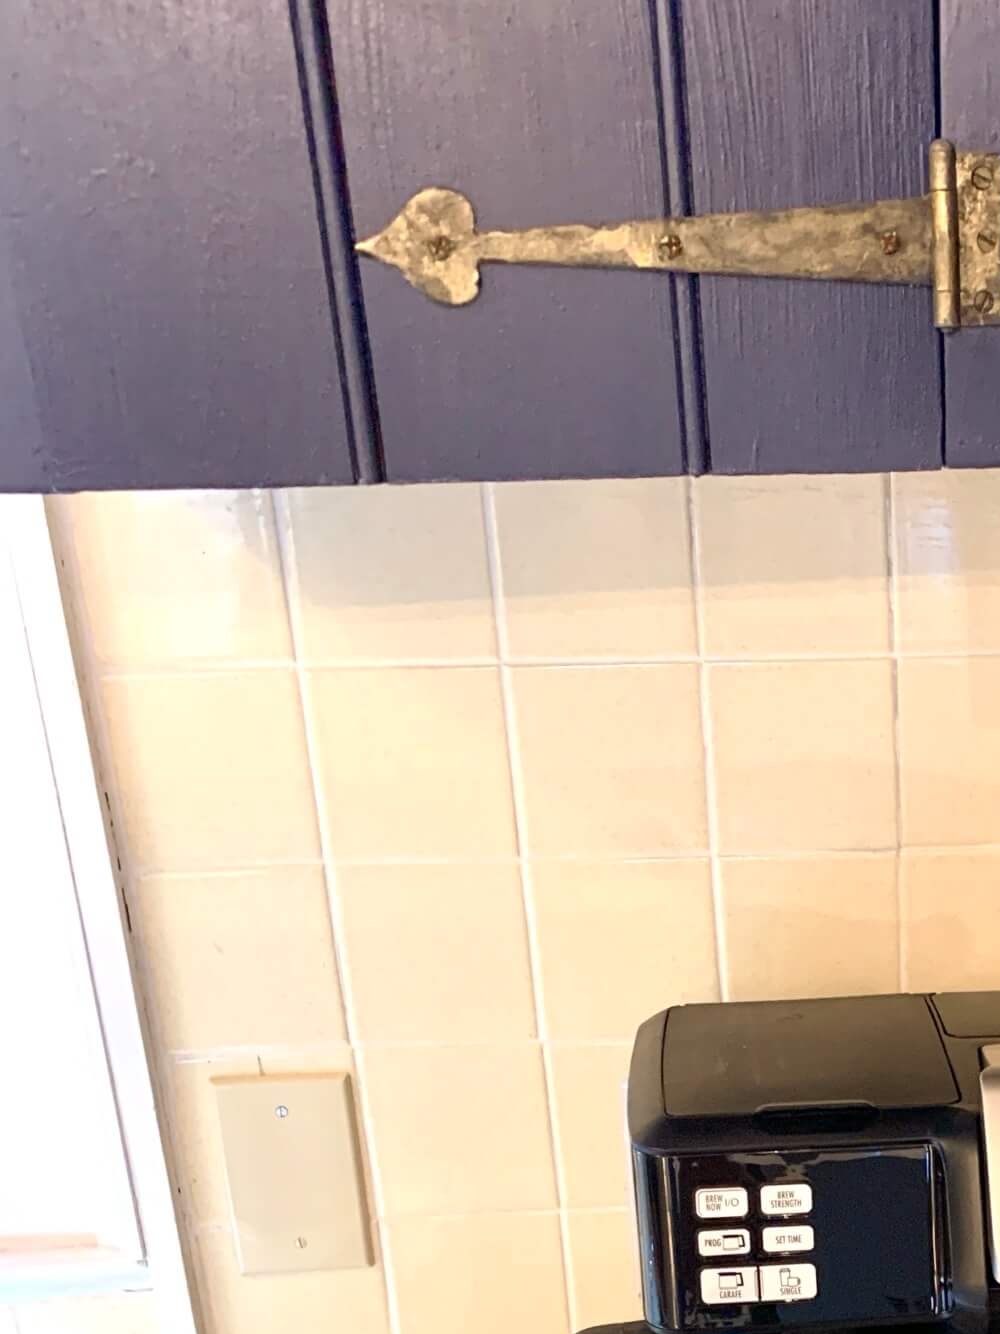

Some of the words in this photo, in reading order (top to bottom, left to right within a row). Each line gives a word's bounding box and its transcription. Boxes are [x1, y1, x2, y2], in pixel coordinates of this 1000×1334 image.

[705, 1194, 723, 1203] BREW
[706, 1203, 721, 1212] NOW
[771, 1199, 802, 1208] STRENGTH
[704, 1239, 722, 1247] PROG
[776, 1236, 786, 1244] SET
[788, 1234, 802, 1244] TIME
[720, 1290, 742, 1298] CARAFE
[780, 1287, 802, 1296] SINGLE
